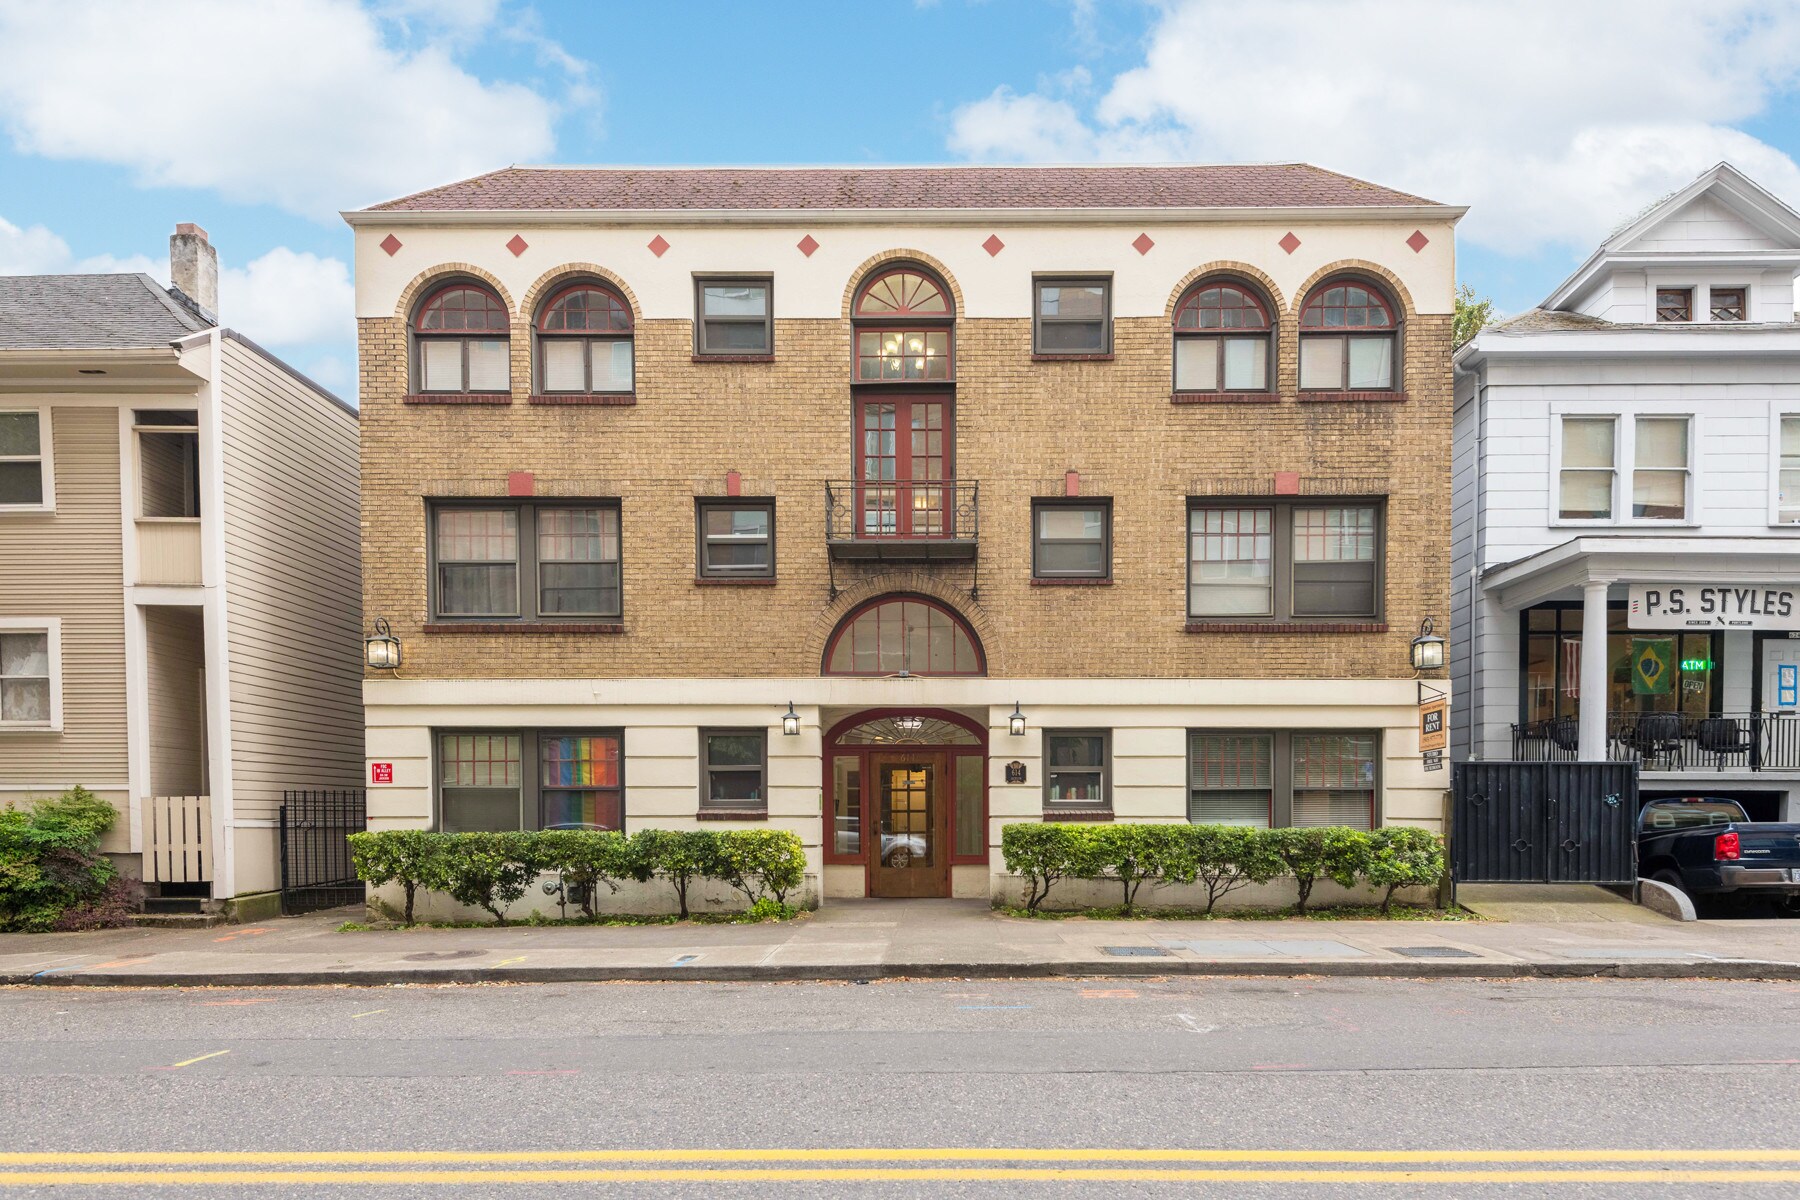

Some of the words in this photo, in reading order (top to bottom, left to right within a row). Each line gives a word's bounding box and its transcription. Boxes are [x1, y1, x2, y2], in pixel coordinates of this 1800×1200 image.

[1645, 588, 1691, 616] P.S.
[1700, 588, 1793, 617] STYLES
[1682, 661, 1704, 670] ATM
[1684, 680, 1703, 690] OPEN
[1427, 712, 1438, 723] FOR
[1425, 722, 1440, 732] RENT
